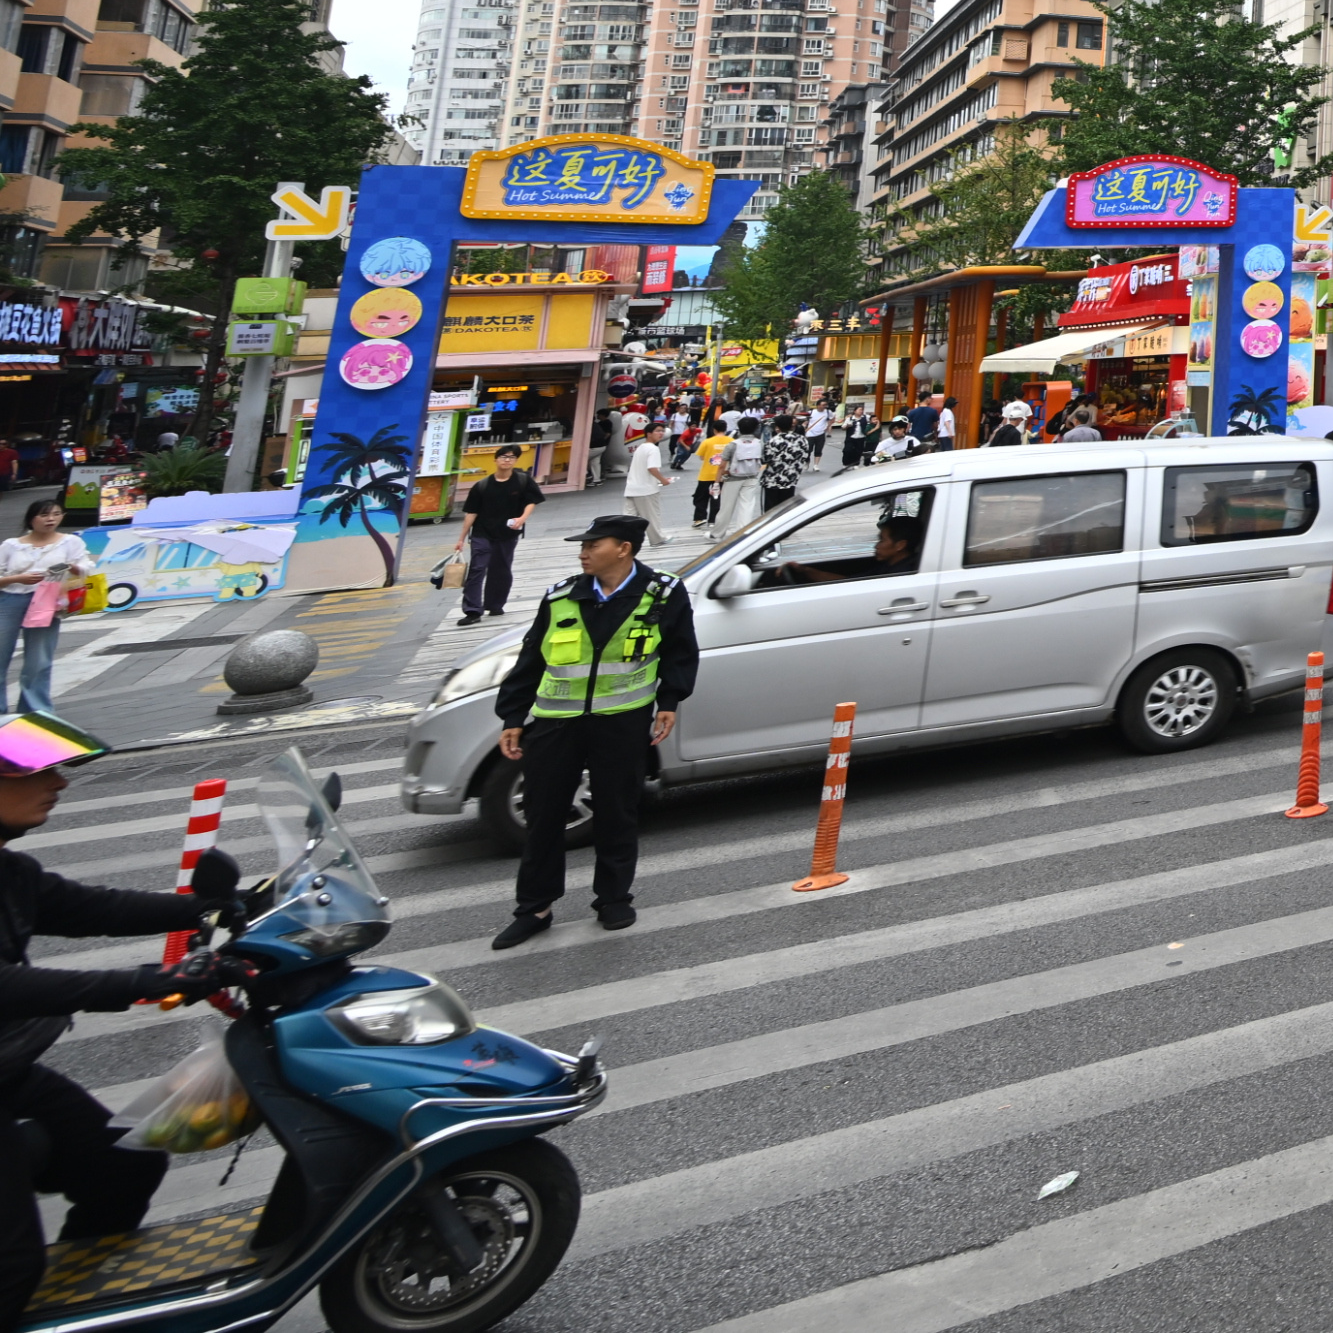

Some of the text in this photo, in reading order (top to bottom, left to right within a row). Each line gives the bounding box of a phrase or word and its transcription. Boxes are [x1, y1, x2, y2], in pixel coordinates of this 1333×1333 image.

[508, 150, 660, 205] 这夏可好
[510, 189, 538, 202] Hot
[666, 180, 695, 197] Qing
[1095, 168, 1200, 213] 这夏可好
[1203, 191, 1226, 205] Qing
[1098, 203, 1118, 214] Hot
[455, 326, 519, 334] DAKOTEA
